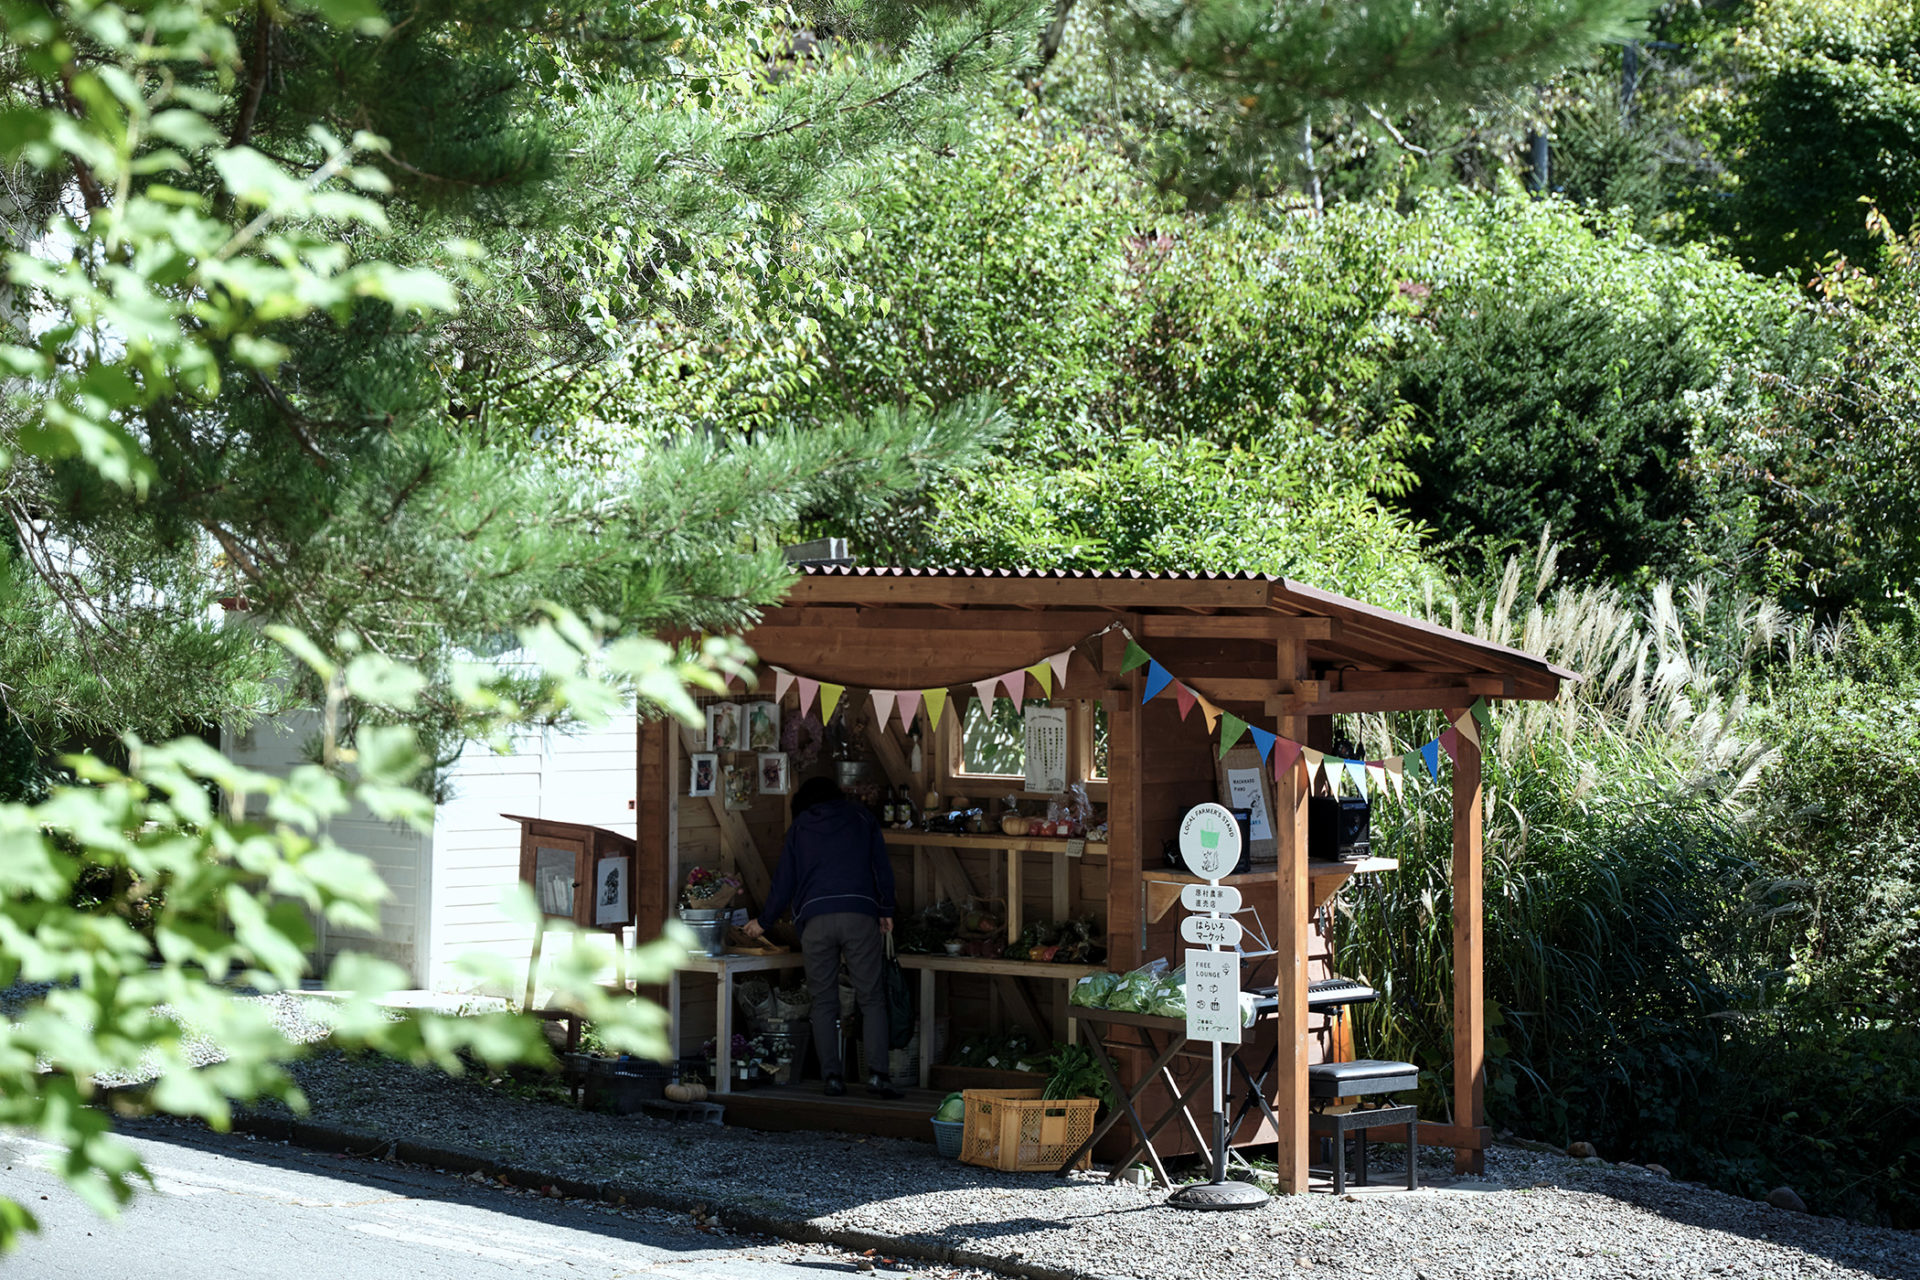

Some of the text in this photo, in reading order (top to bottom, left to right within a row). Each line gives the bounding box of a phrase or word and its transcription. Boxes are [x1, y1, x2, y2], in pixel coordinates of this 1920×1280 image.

[1184, 808, 1235, 837] LOCAL FARMER'S STAND
[1196, 921, 1225, 931] はらいろ
[1196, 932, 1225, 942] マーケット
[1195, 961, 1211, 969] FREE
